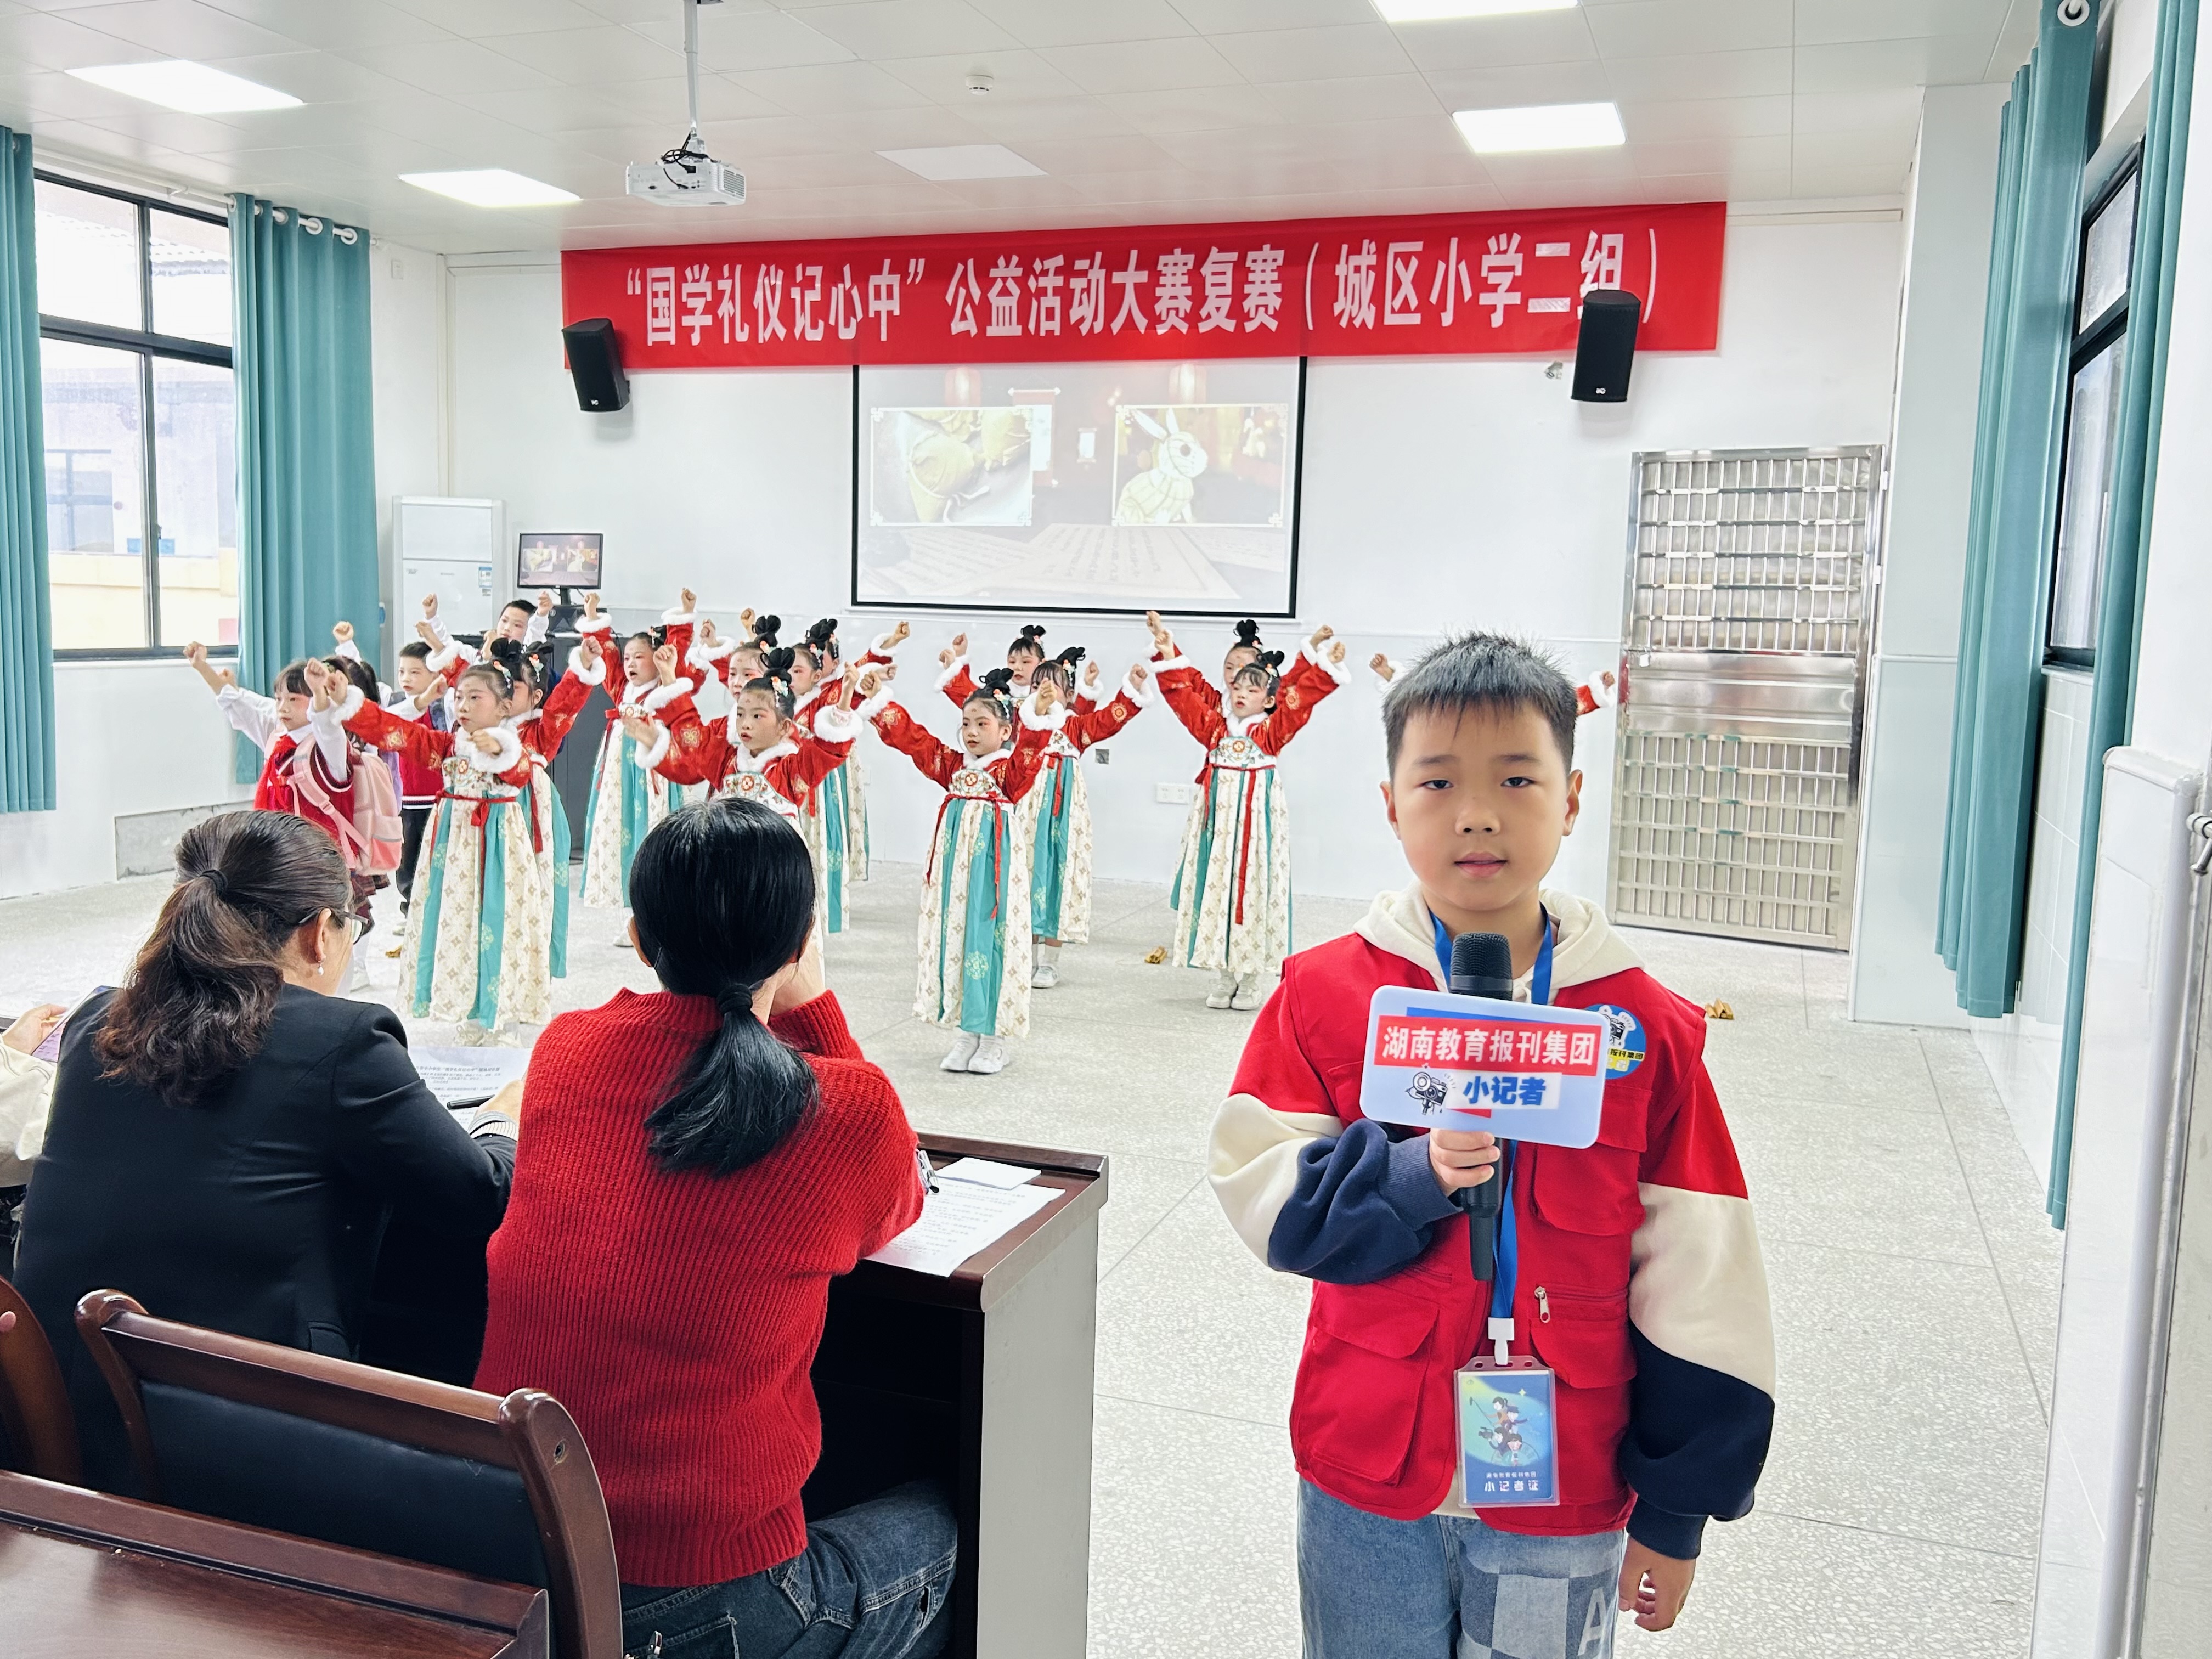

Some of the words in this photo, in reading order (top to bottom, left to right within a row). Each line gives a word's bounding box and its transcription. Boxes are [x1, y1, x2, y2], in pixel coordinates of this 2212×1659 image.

[1382, 1026, 1596, 1066] 湖南教育报刊集团
[1463, 1076, 1547, 1106] 小记者
[1485, 1480, 1539, 1492] 小记者证
